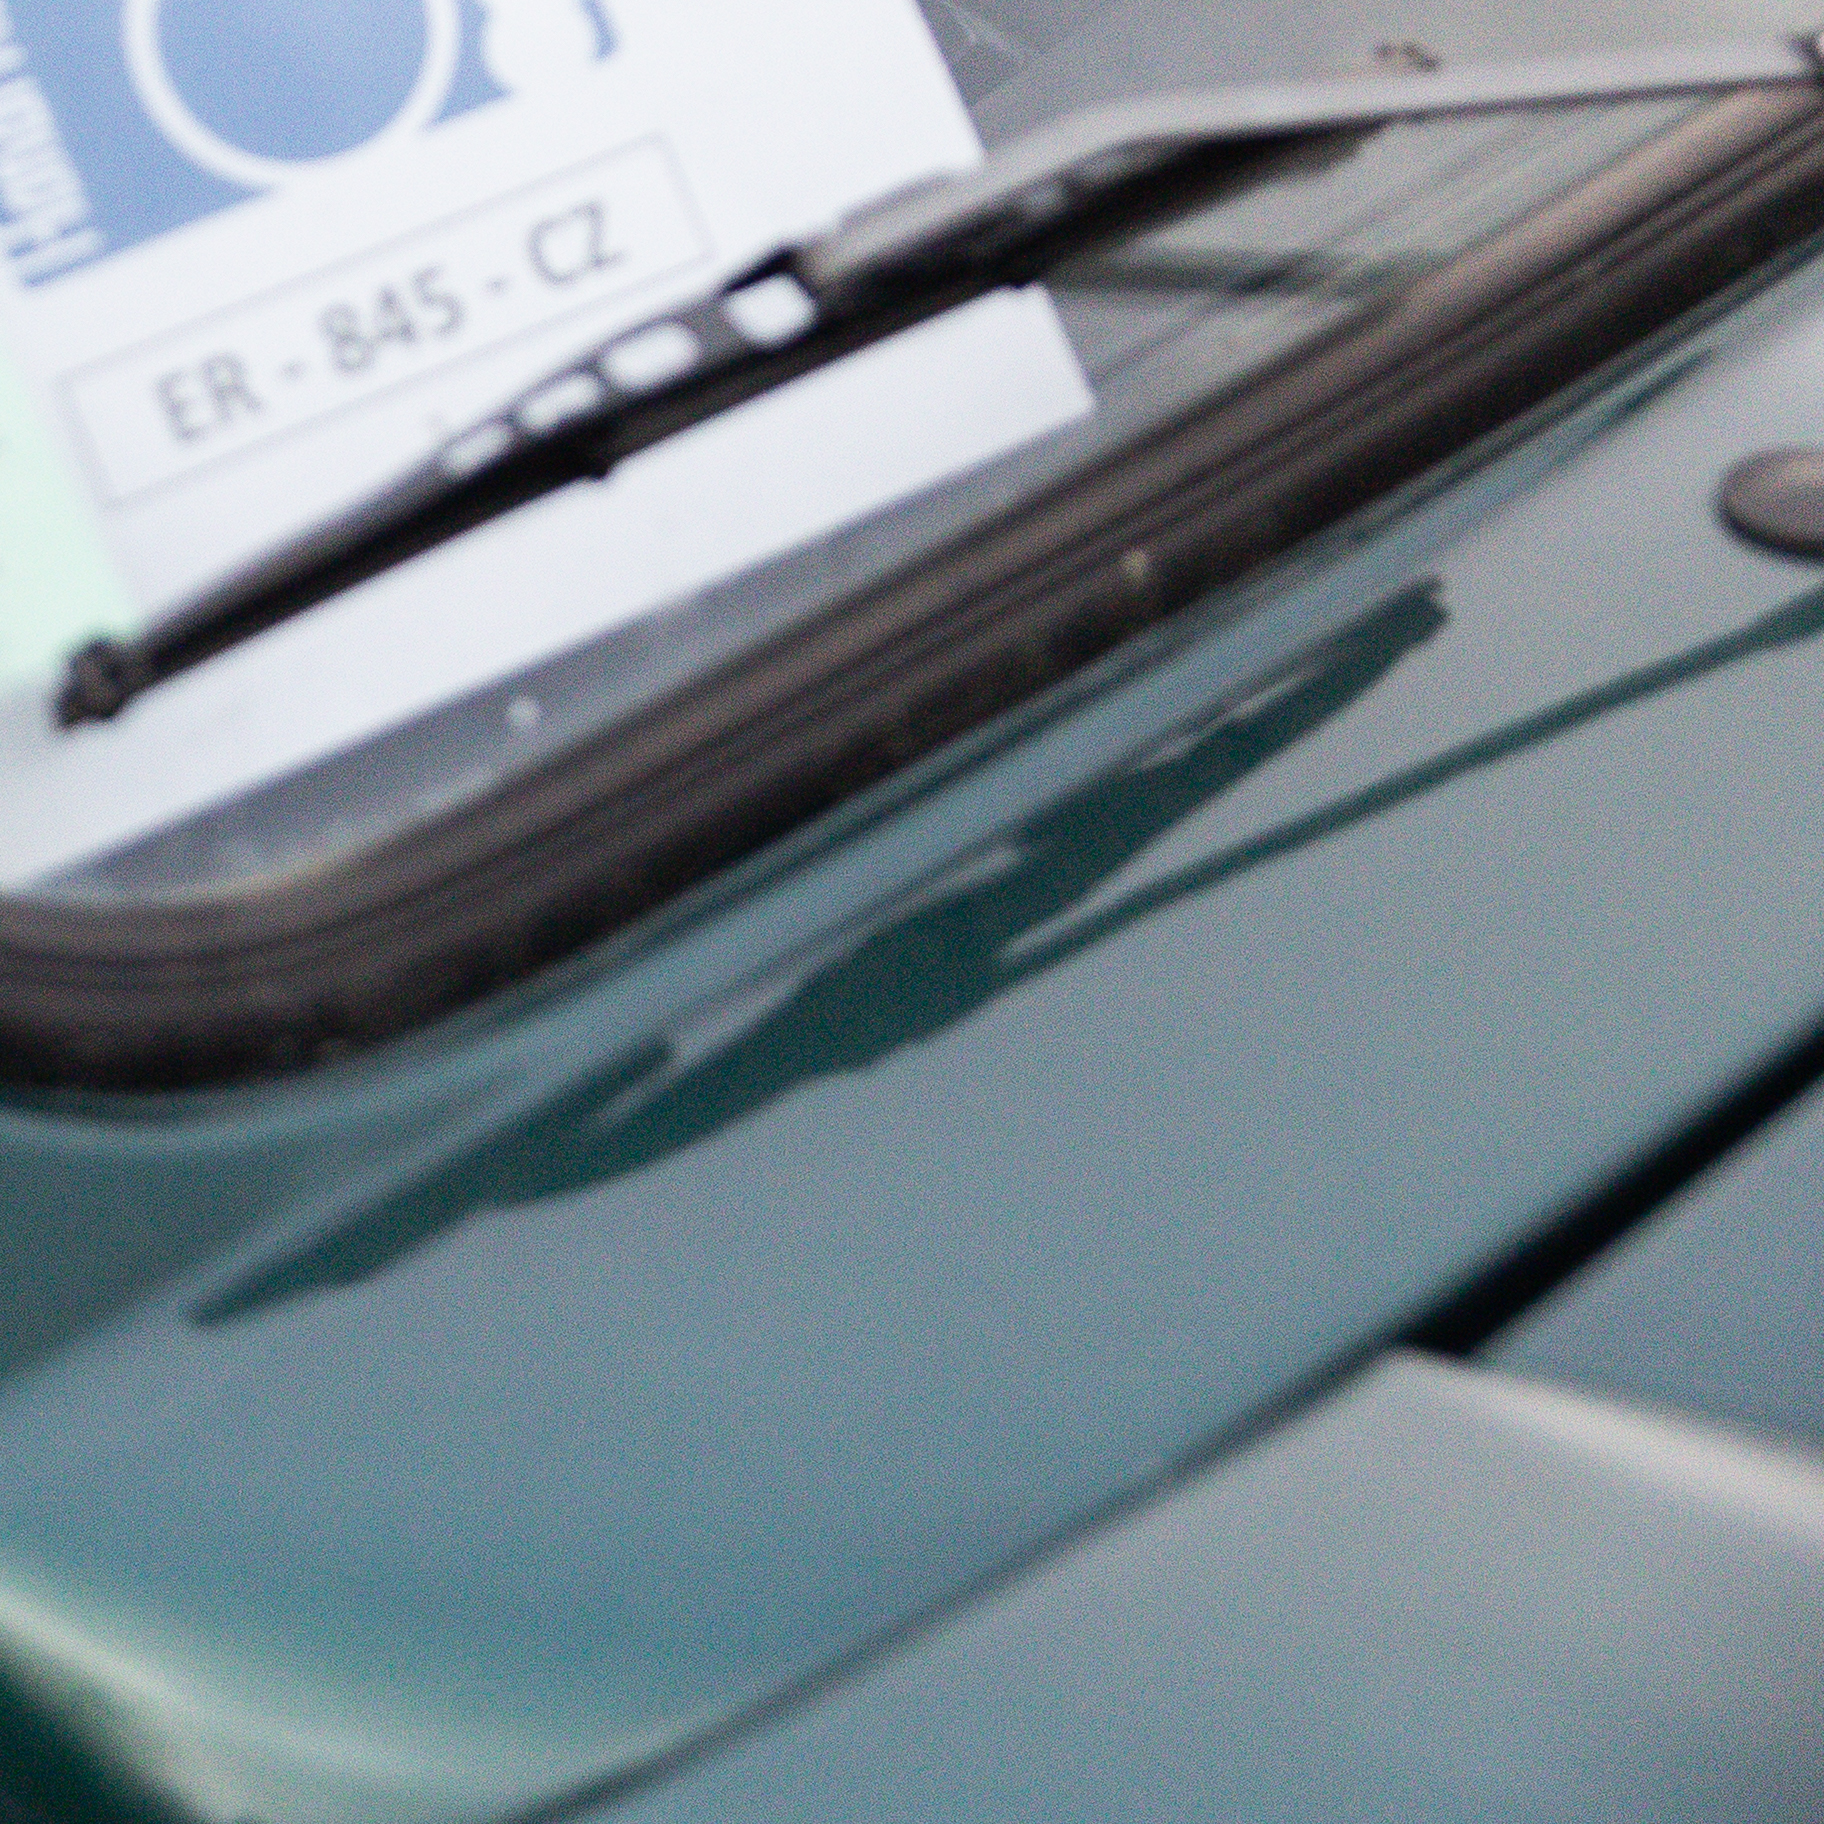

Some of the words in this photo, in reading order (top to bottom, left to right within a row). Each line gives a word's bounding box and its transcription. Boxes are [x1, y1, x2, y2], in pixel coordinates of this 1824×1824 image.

[152, 351, 263, 445] ER
[317, 265, 465, 375] 845
[526, 198, 635, 288] CZ
